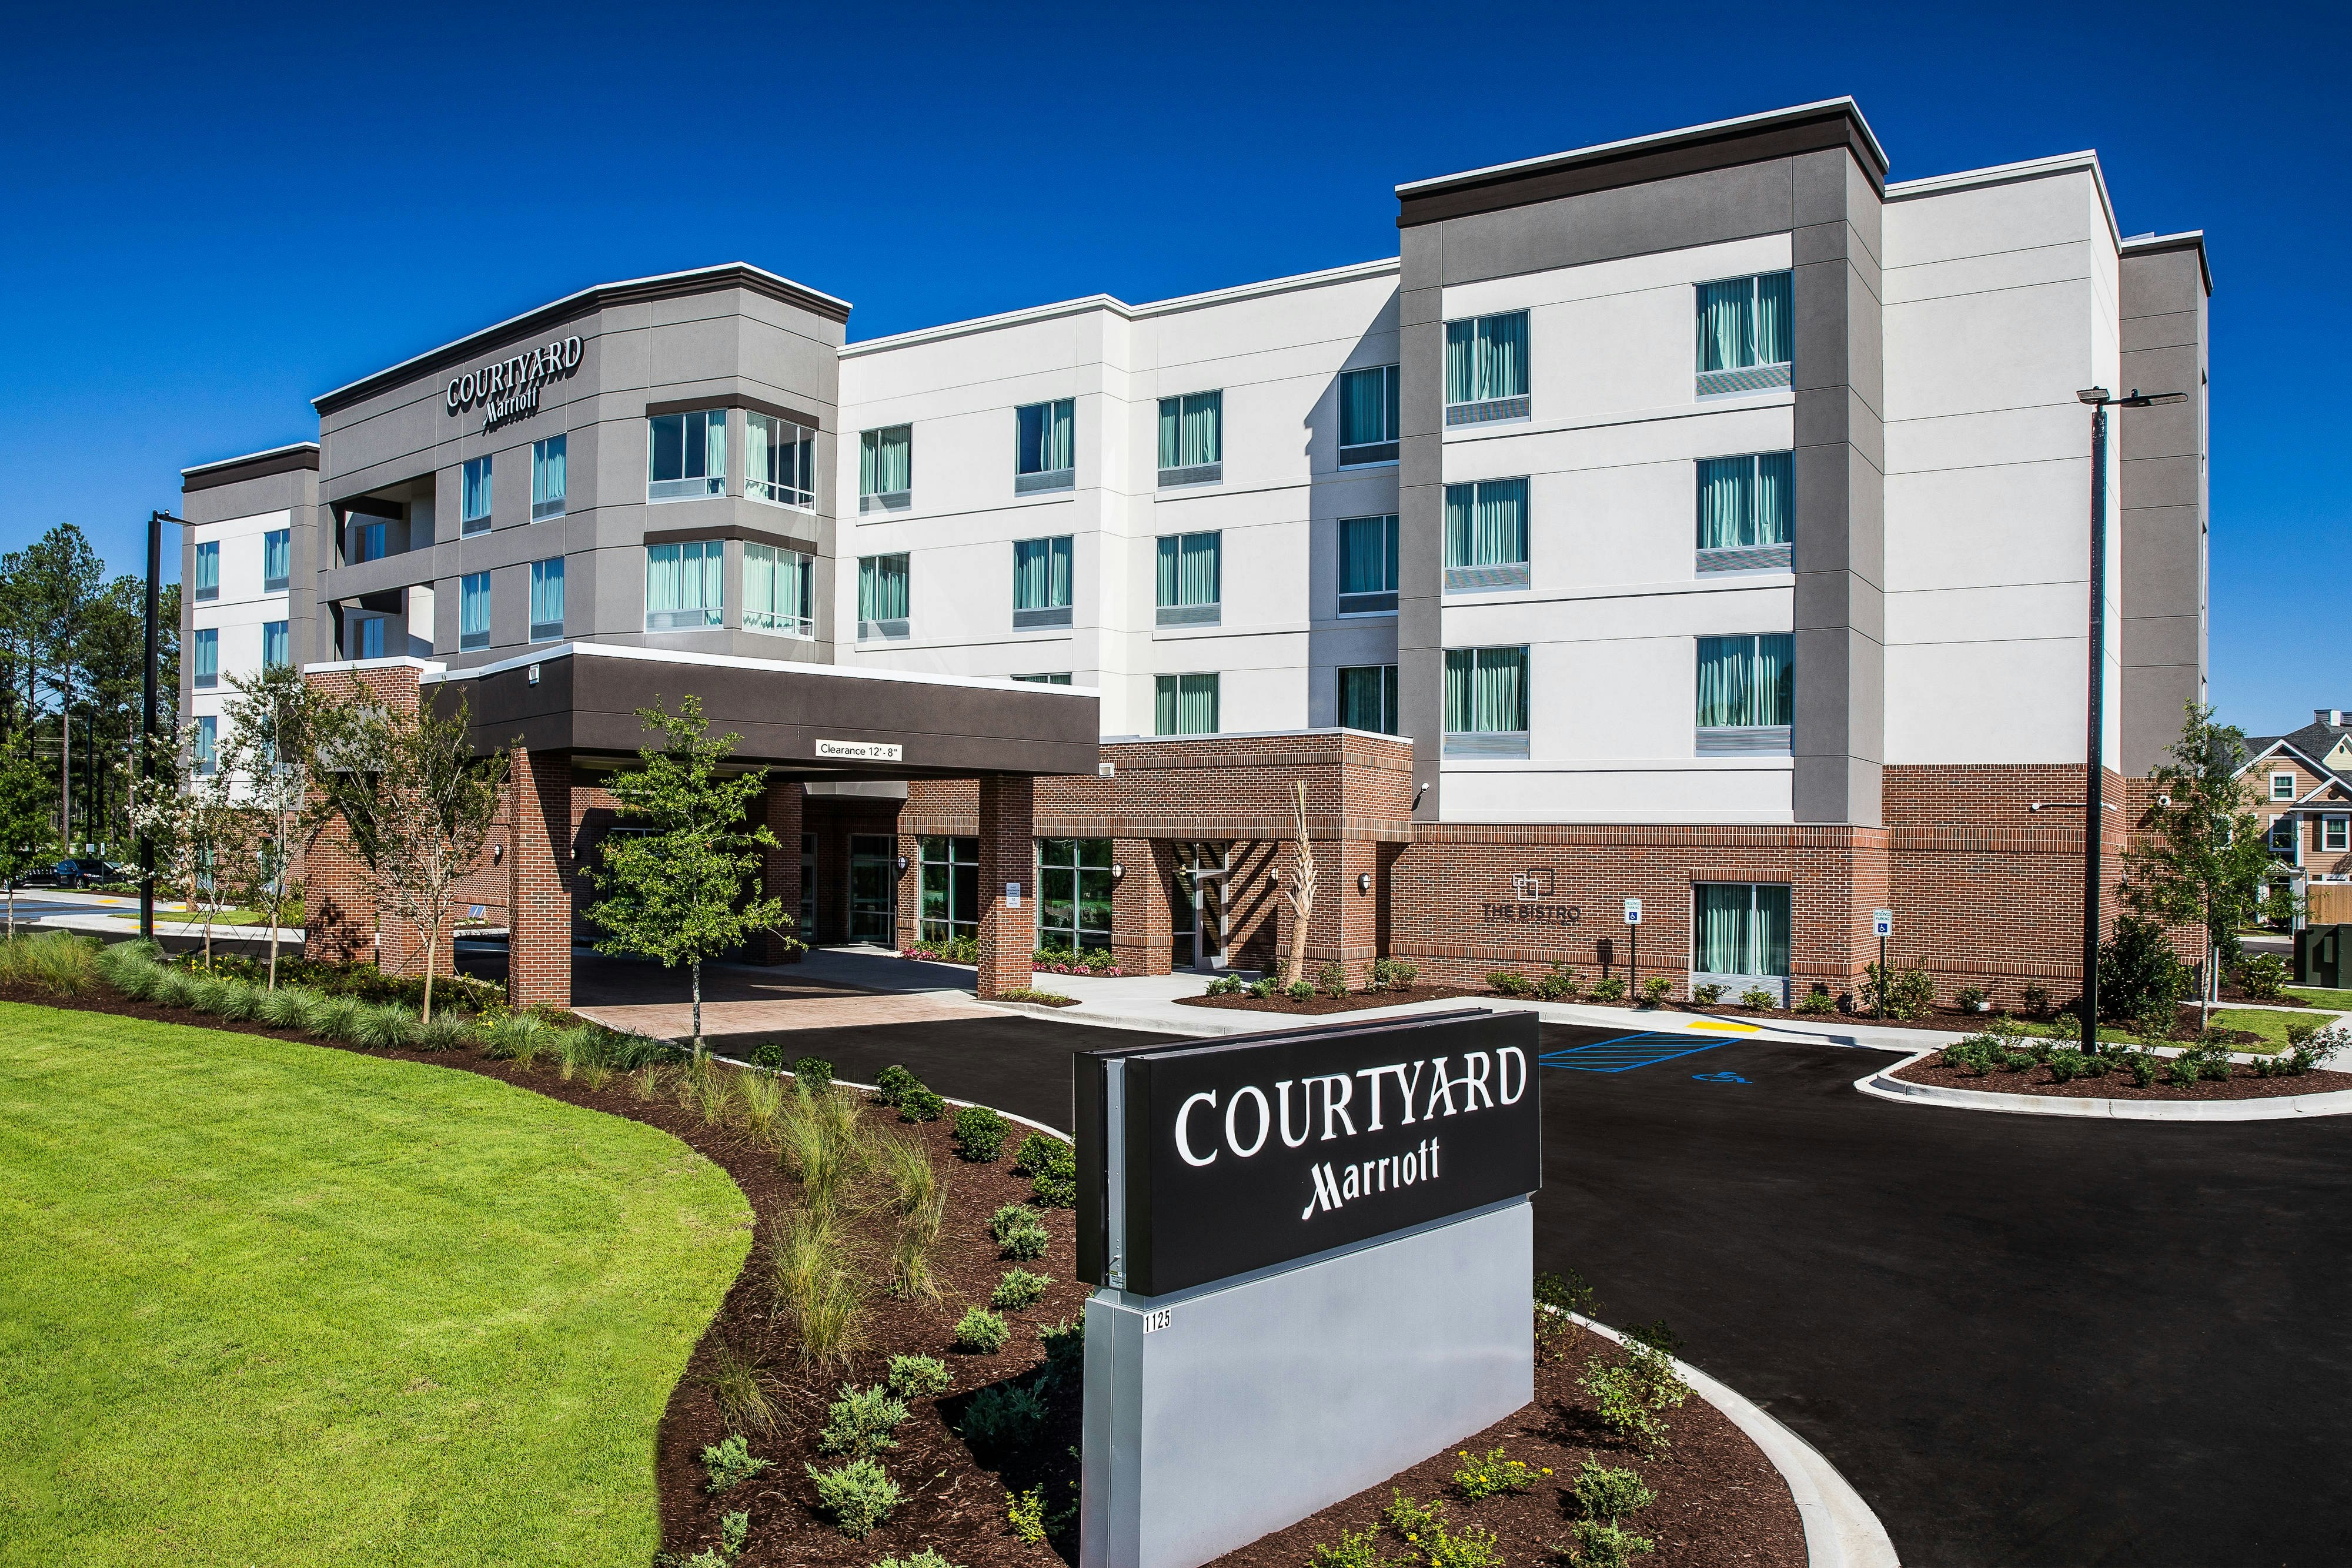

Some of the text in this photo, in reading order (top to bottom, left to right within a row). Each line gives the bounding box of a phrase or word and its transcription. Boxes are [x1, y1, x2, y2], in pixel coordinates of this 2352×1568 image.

[447, 335, 583, 407] COURTYARD
[483, 386, 539, 426] Marriott
[821, 744, 866, 755] Clearance
[1482, 904, 1581, 921] THE BISTRO
[1175, 1046, 1527, 1166] COURTYARD
[1301, 1136, 1440, 1220] Marriott
[1146, 1310, 1170, 1332] 1125
